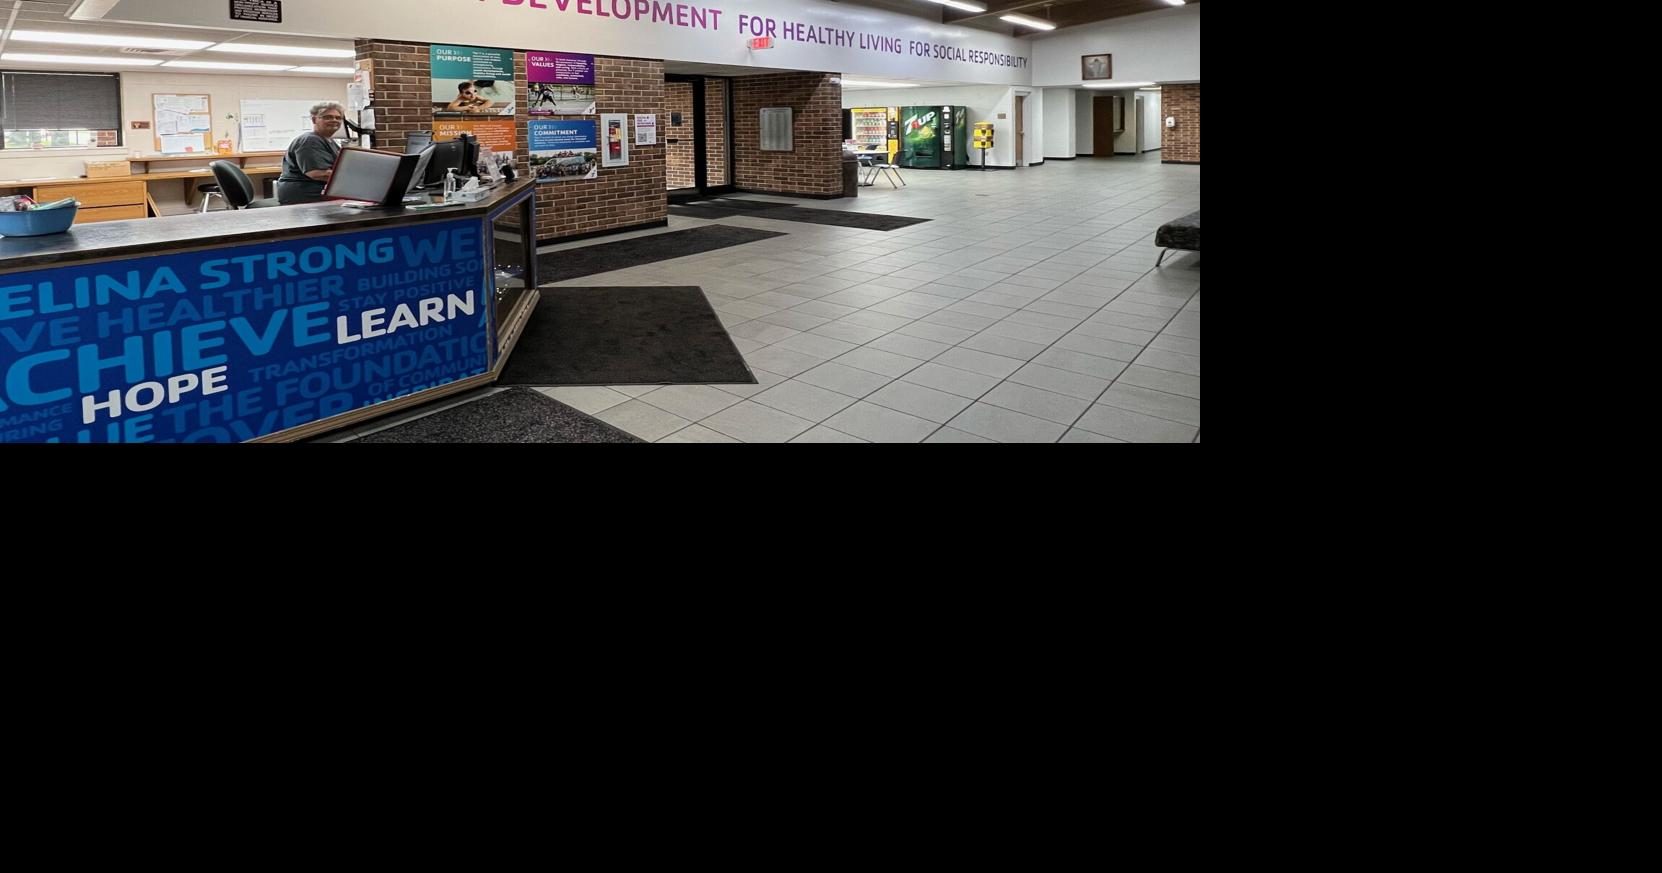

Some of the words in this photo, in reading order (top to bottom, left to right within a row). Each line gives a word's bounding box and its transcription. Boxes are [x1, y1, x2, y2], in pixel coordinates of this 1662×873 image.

[739, 14, 776, 38] FOR
[783, 21, 855, 48] HEALTHY
[860, 33, 901, 54] LIVING
[909, 41, 930, 58] FOR
[933, 44, 966, 61] SOCIAL
[969, 49, 1028, 69] RESPONSIBILITY
[753, 38, 769, 48] EXIT
[0, 266, 187, 319] ELINA
[200, 238, 394, 290] STRONG
[97, 275, 345, 339] HEALTHIER
[358, 263, 450, 291] BUILDING
[339, 292, 388, 312] STAY
[394, 276, 475, 300] POSITIVE
[0, 302, 331, 412] CHIEVE
[337, 290, 475, 344] LEARN
[82, 366, 229, 425] HOPE
[248, 324, 452, 383] TRANSFORMATION
[162, 387, 264, 433] THE
[369, 380, 394, 396] OF
